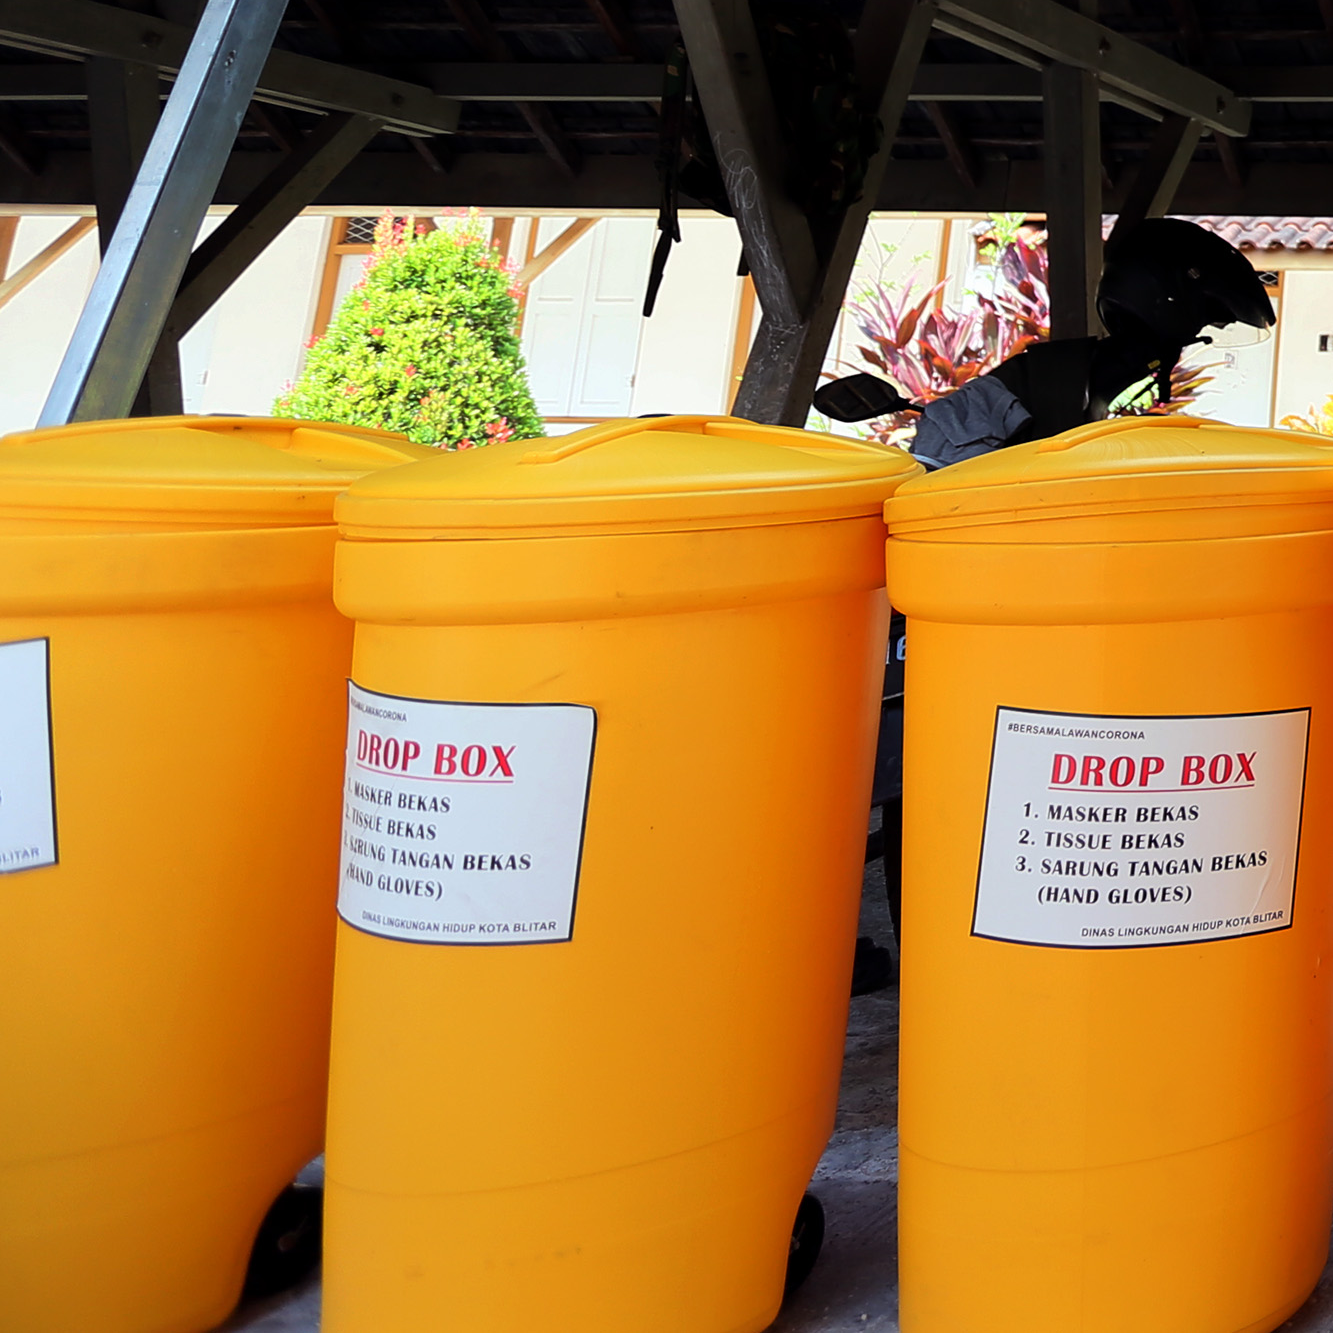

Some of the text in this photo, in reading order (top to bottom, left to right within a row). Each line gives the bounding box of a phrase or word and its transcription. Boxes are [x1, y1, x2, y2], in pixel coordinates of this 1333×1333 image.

[1007, 723, 1146, 740] #BERSAMALAWANCORONA
[357, 729, 517, 778] DROP BOX
[1051, 751, 1257, 787] DROP BOX
[354, 780, 392, 807] MASKER
[397, 792, 451, 813] BEKAS
[352, 807, 382, 833] TISSUE
[387, 819, 437, 841] BEKAS
[1023, 802, 1199, 822] 1. MASKER BEKAS
[1018, 830, 1186, 850] 2. TISSUE BEKAS
[0, 847, 40, 864] LITAR
[391, 847, 455, 870] TANGAN
[462, 854, 532, 871] BEKAS
[1015, 851, 1268, 877] 3. SARUNG TANGAN BEKAS
[377, 874, 443, 902] GLOVES)
[1037, 885, 1193, 905] (HAND GLOVES)
[362, 910, 557, 934] DINAS LINGKUNGAN HIDUP KOTA BLITAR
[1081, 911, 1283, 937] DINAS LINGKUNGAN HIDUP KOTA BLITAR
